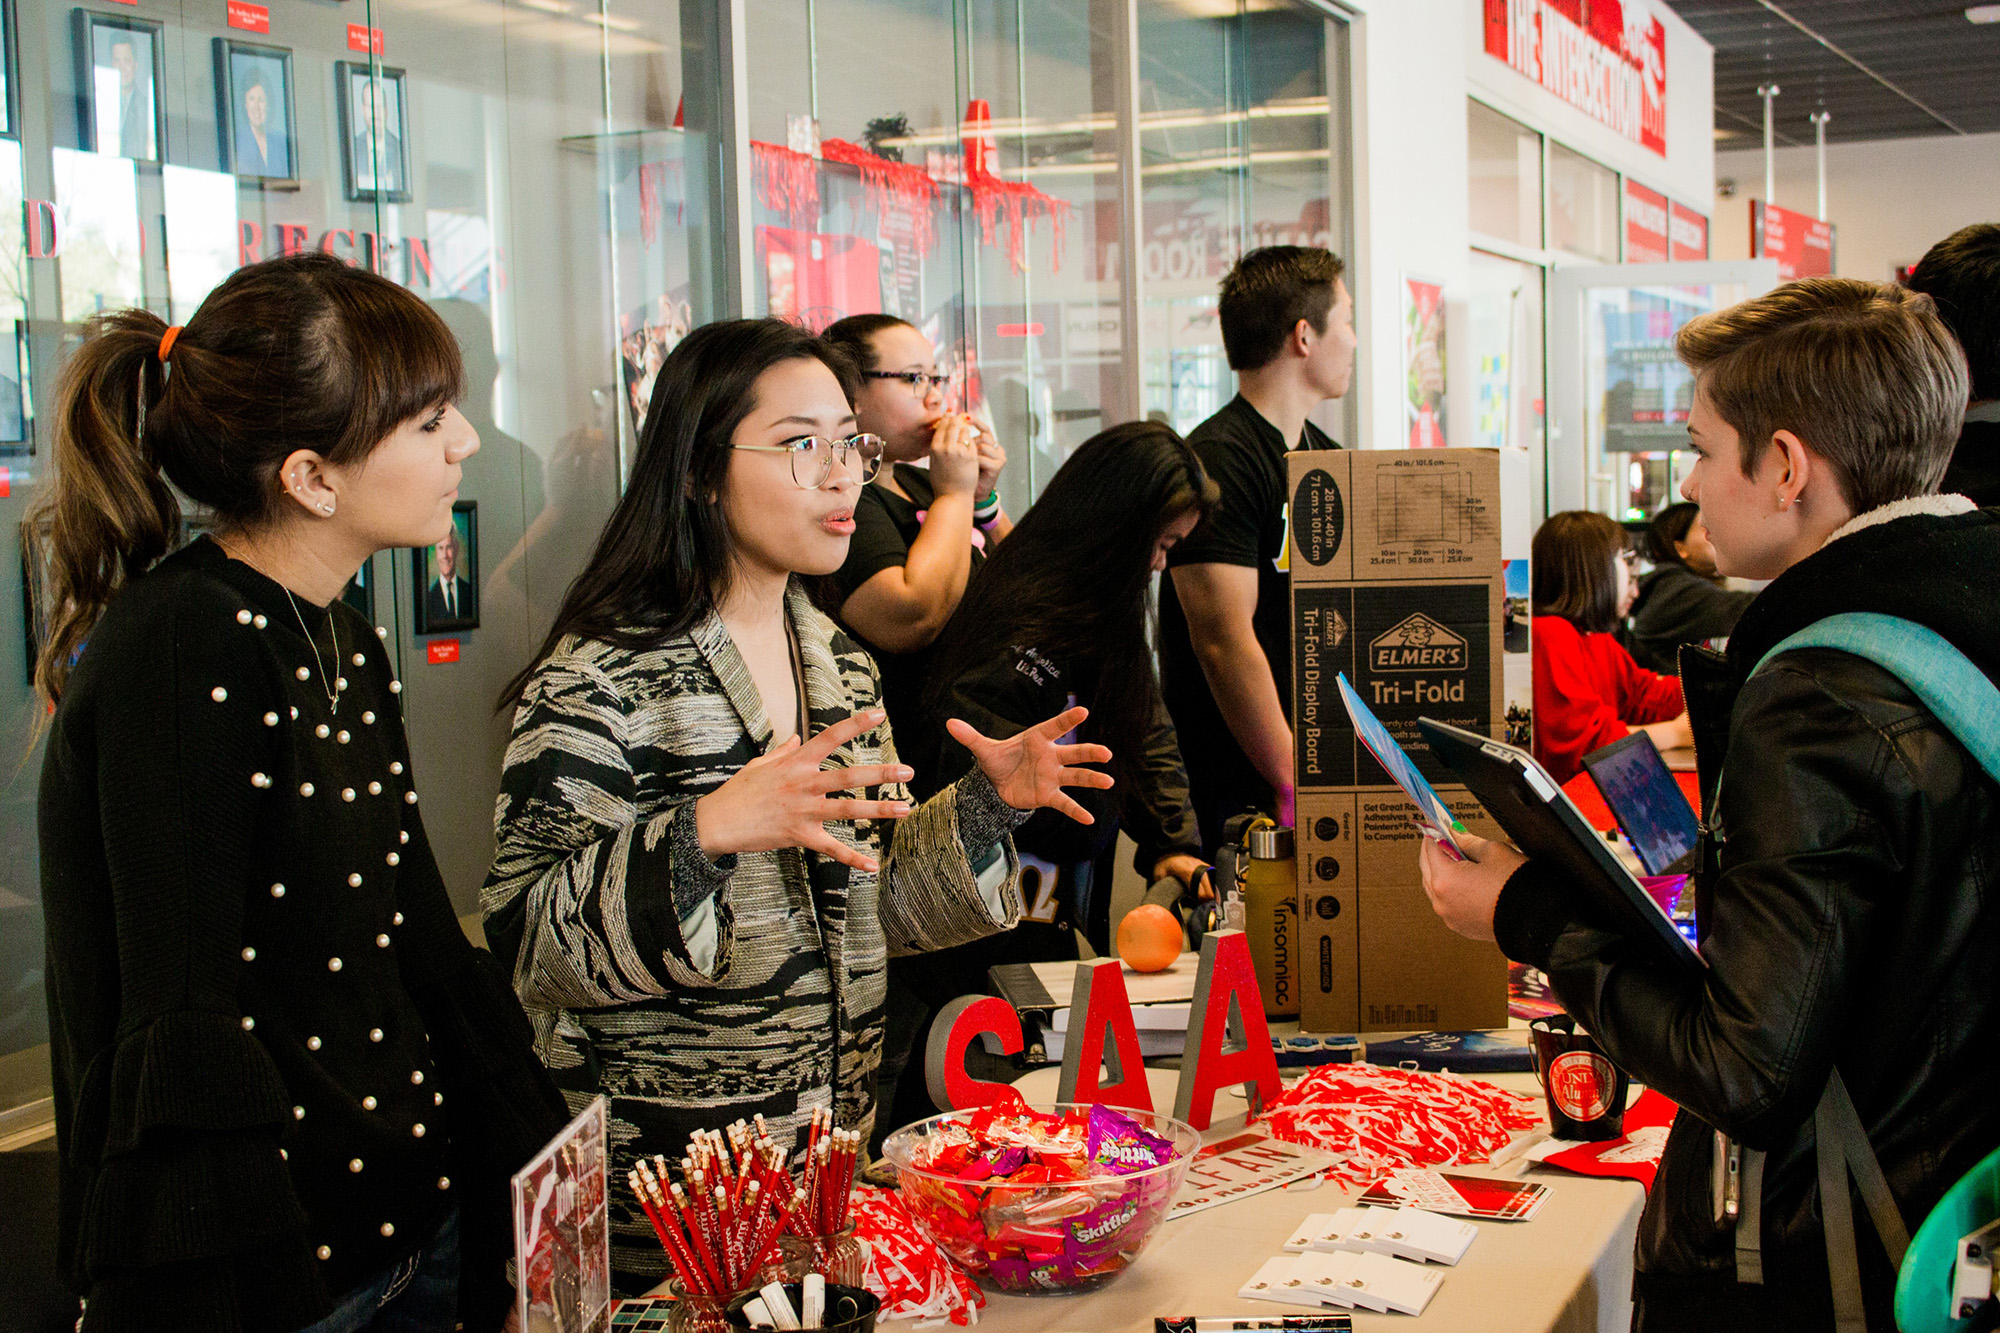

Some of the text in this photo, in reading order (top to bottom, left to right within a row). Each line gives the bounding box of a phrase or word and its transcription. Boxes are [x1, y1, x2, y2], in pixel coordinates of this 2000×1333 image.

[238, 220, 507, 292] REGENS
[1311, 475, 1321, 487] 71
[1311, 490, 1319, 506] cm
[1324, 488, 1335, 500] 28
[1325, 503, 1335, 513] in
[1312, 517, 1322, 544] 101.6
[1325, 523, 1335, 537] 40
[1326, 538, 1336, 548] in
[1312, 545, 1320, 561] cm
[1377, 648, 1461, 666] ELMER'S
[1303, 608, 1322, 774] Tri-Fold Display Board
[1370, 680, 1465, 704] Tri-Fold
[1451, 718, 1478, 726] board
[1364, 803, 1379, 812] Get
[1380, 803, 1403, 811] Great
[1375, 832, 1414, 841] Complete
[1274, 907, 1291, 1006] insomniac
[1189, 1146, 1301, 1183] FAN
